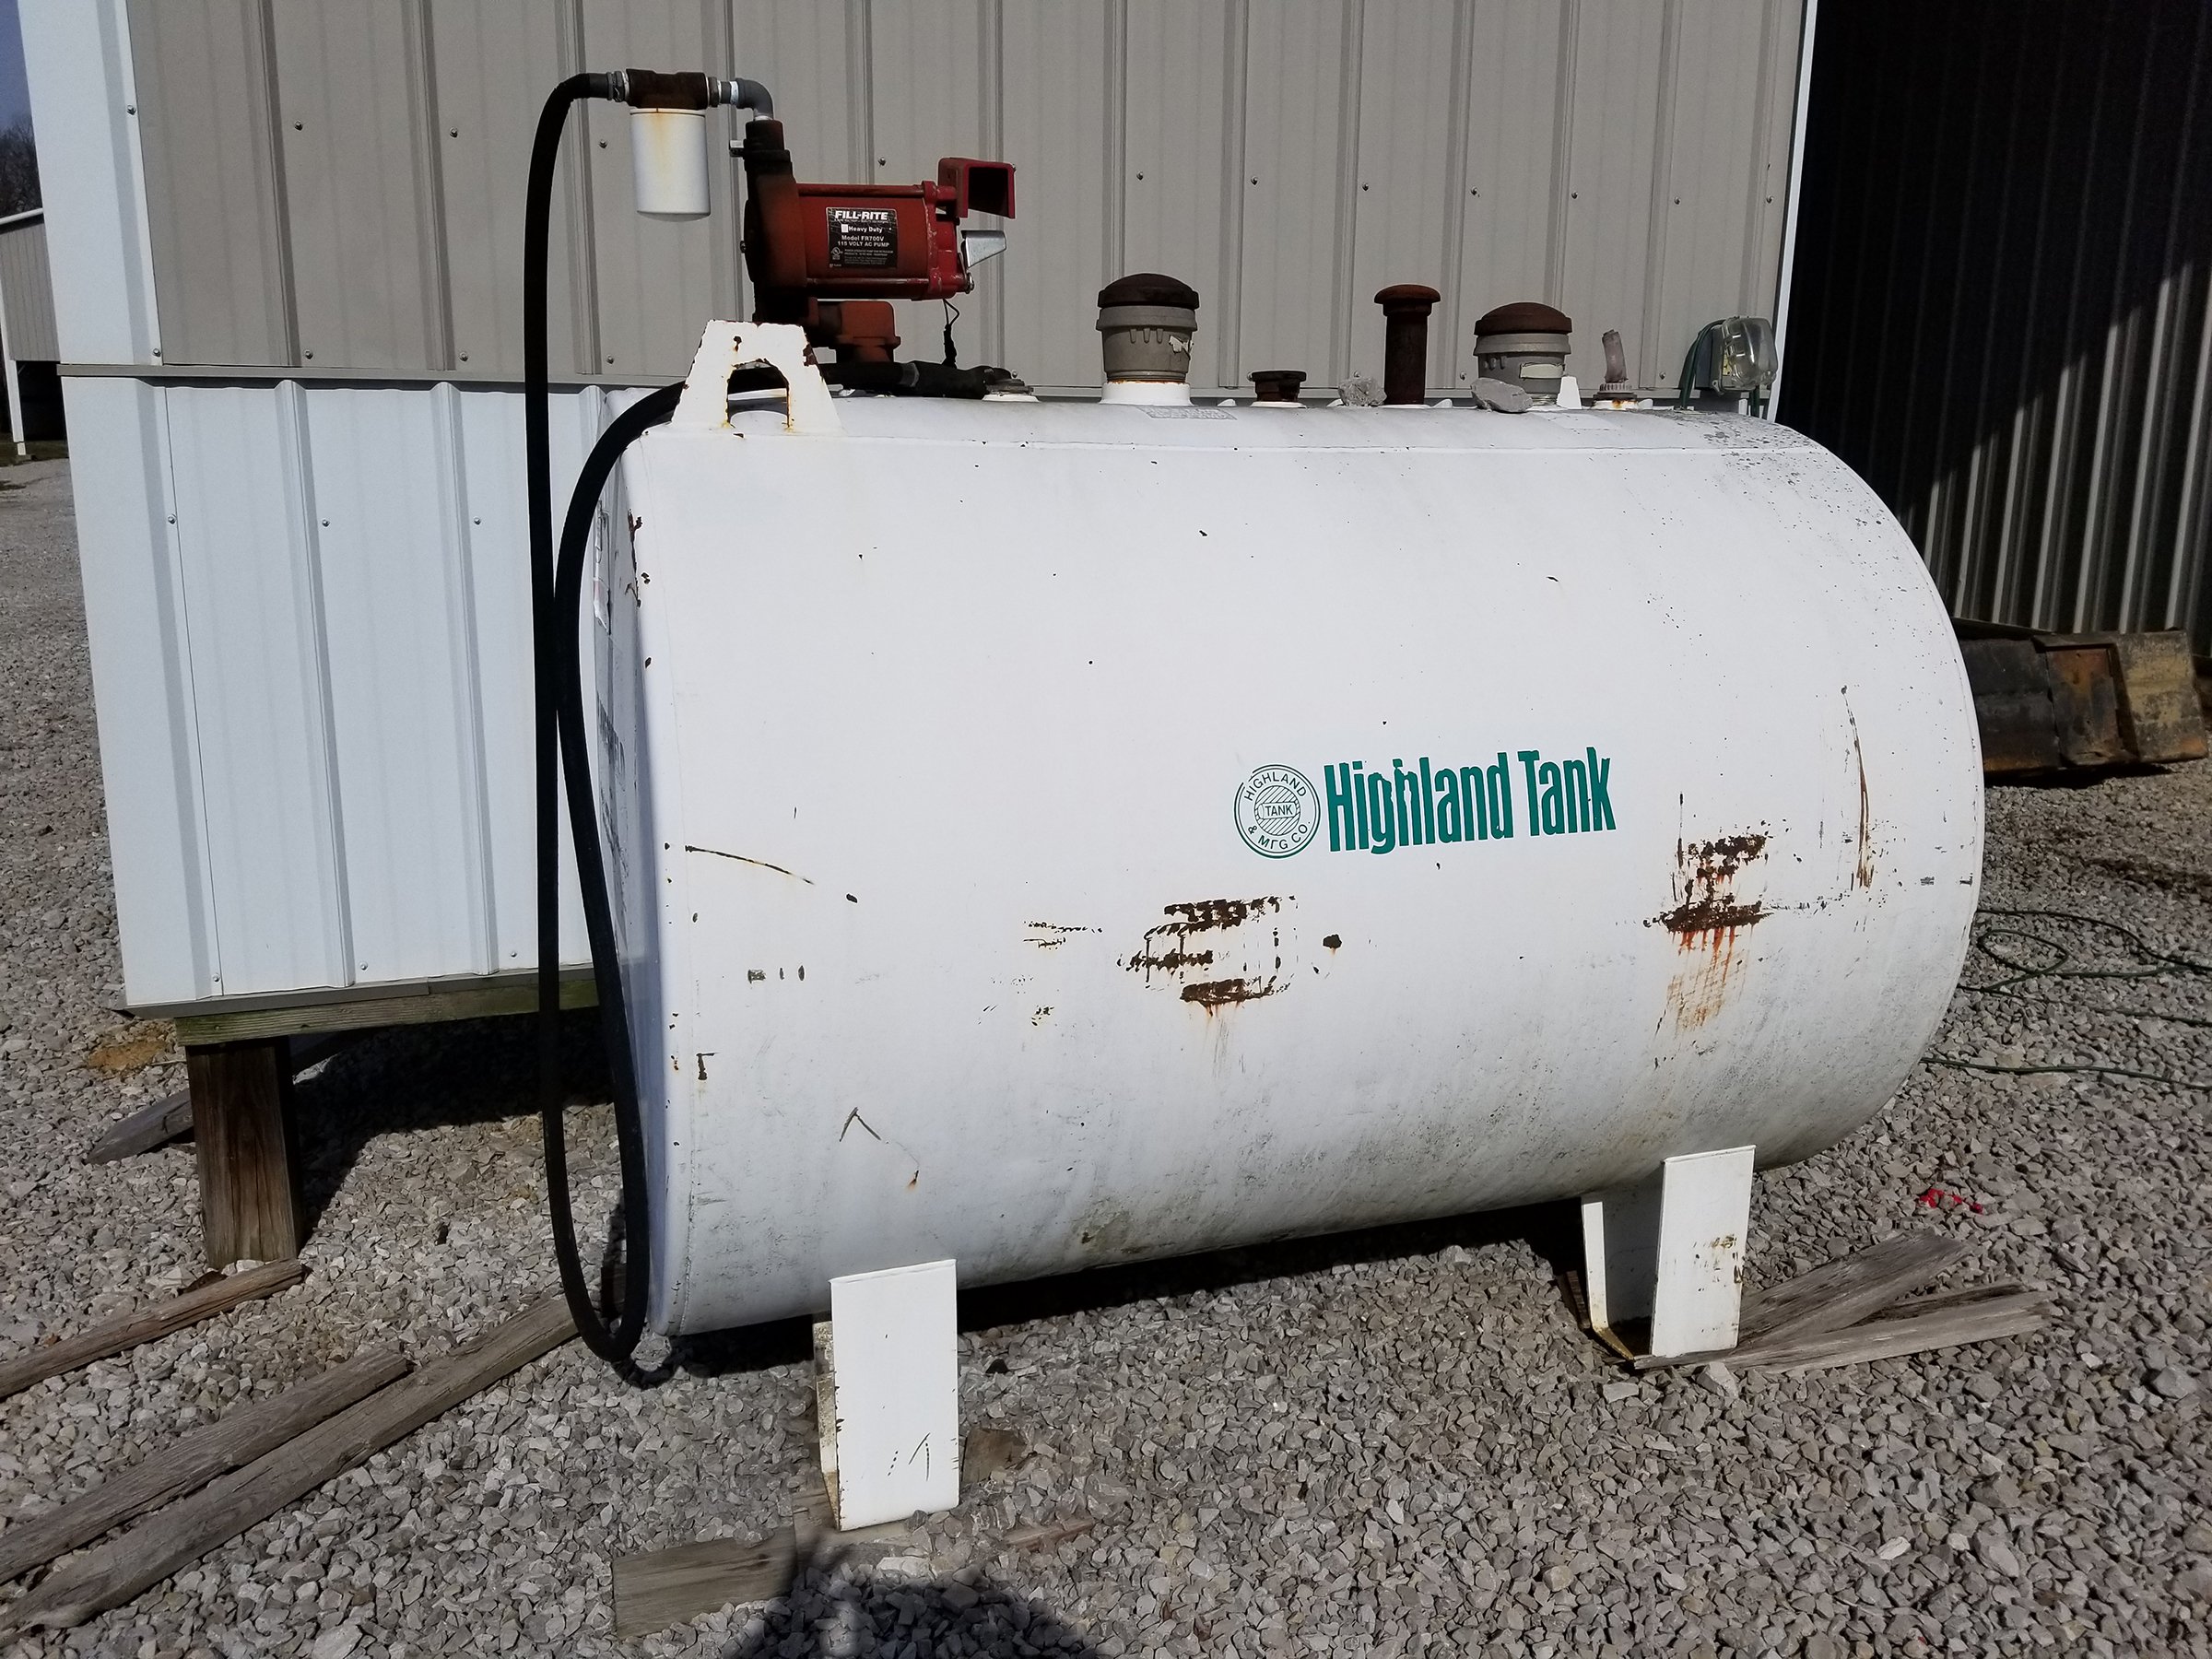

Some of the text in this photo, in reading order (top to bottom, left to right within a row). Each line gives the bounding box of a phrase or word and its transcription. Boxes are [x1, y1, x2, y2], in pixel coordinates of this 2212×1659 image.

[835, 210, 888, 220] FILL-RITE
[1243, 771, 1307, 802] HIGHLAND
[1324, 747, 1617, 854] Highland Tank
[1265, 804, 1293, 817] TANK
[1247, 825, 1258, 835] &
